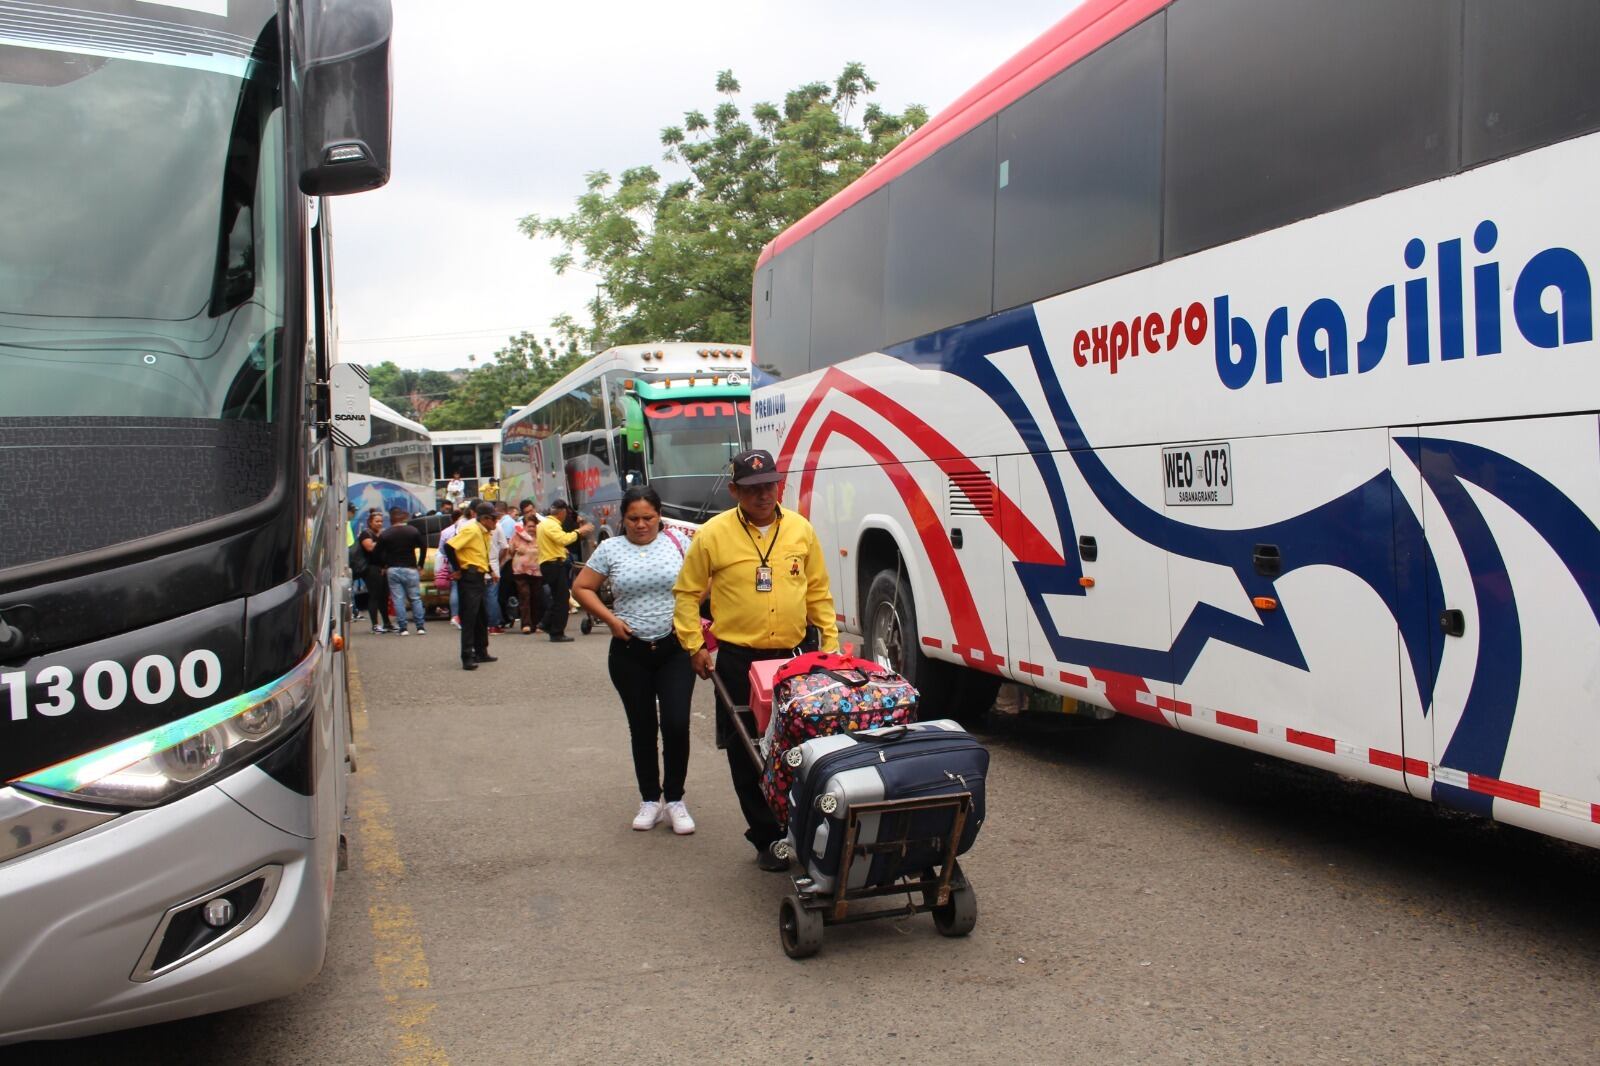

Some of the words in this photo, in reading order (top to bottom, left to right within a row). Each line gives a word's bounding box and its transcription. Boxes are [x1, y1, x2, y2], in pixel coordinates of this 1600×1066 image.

[1073, 301, 1207, 374] expreso
[1214, 219, 1593, 390] brasilia
[755, 393, 786, 419] PREMIUM
[1164, 451, 1193, 488] WEO
[1204, 448, 1228, 487] 073
[1179, 491, 1218, 502] SABANAGRANDE
[1, 649, 221, 720] 13000
